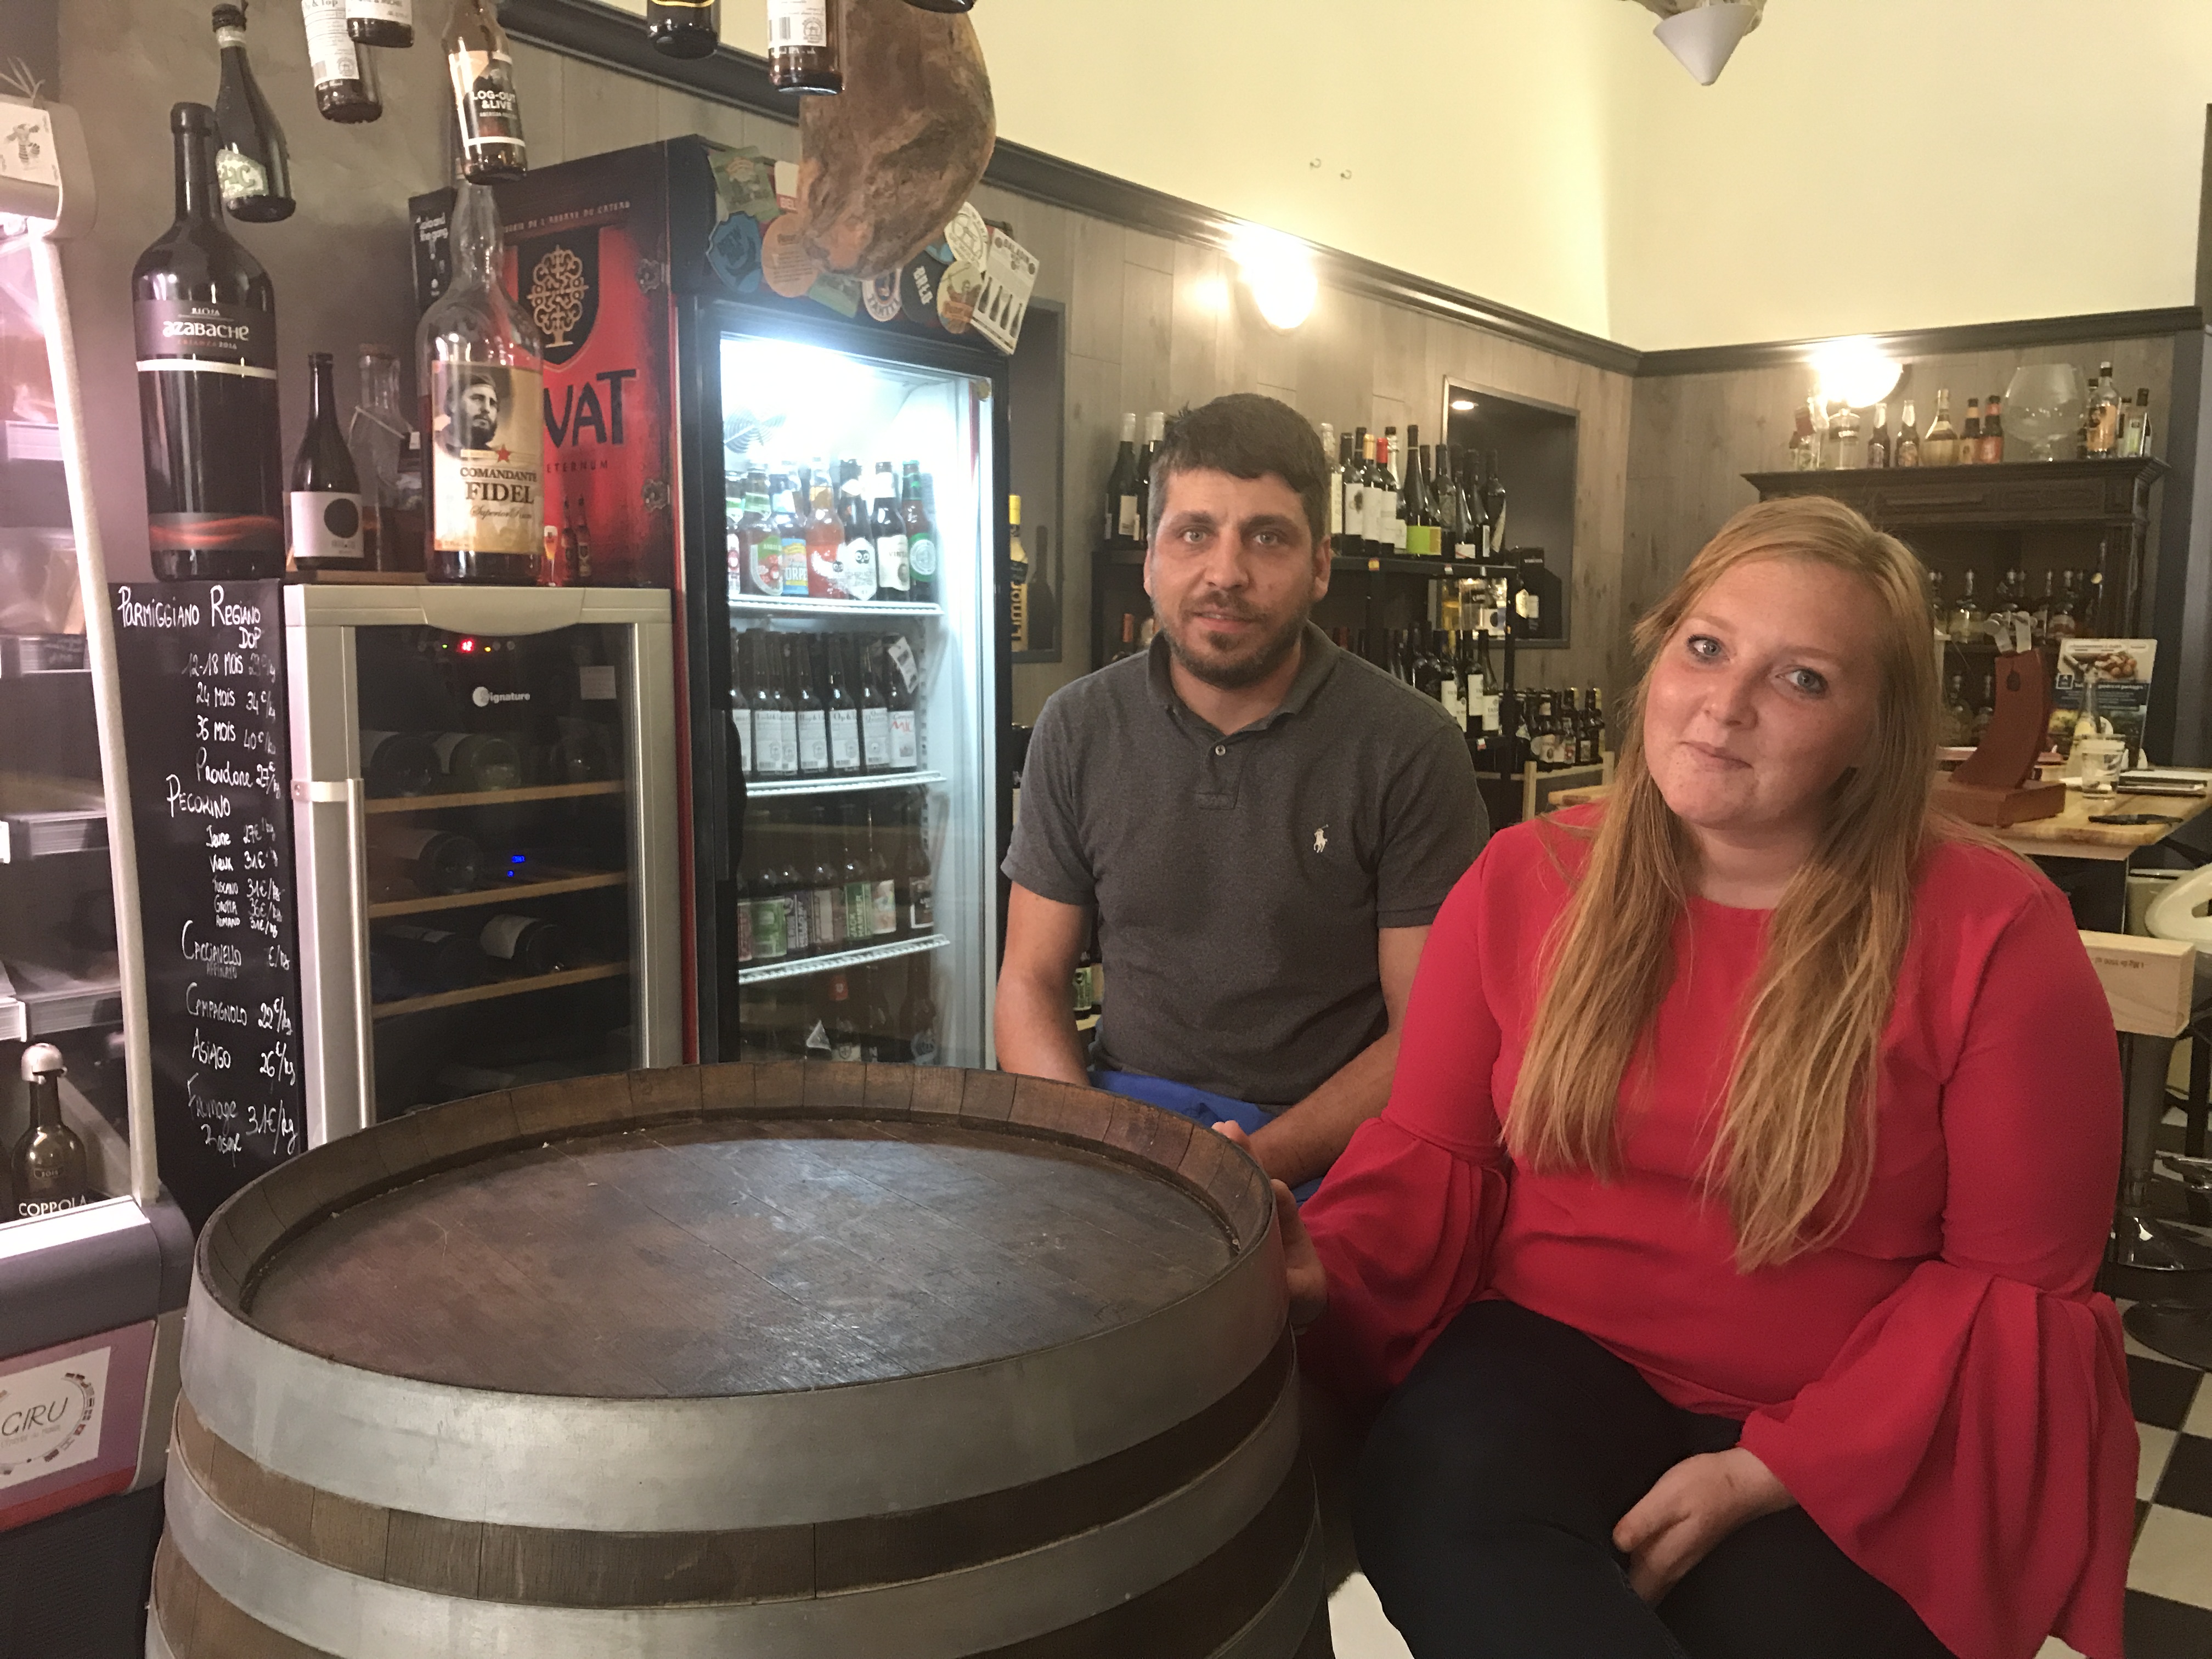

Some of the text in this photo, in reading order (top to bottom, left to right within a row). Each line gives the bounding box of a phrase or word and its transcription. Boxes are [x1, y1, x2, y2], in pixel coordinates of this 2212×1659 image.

[191, 307, 221, 316] RIOJA
[544, 369, 636, 449] VAT
[460, 467, 537, 483] COMANDANTE
[465, 481, 535, 504] FIDEL
[239, 626, 262, 649] DOP
[182, 652, 219, 678] 12-18
[224, 651, 244, 676] MOIS
[196, 681, 210, 707] 24
[214, 687, 236, 708] MOIS
[196, 714, 209, 741] 36
[214, 720, 236, 741] MOIS
[192, 1028, 231, 1070] ASIAGO
